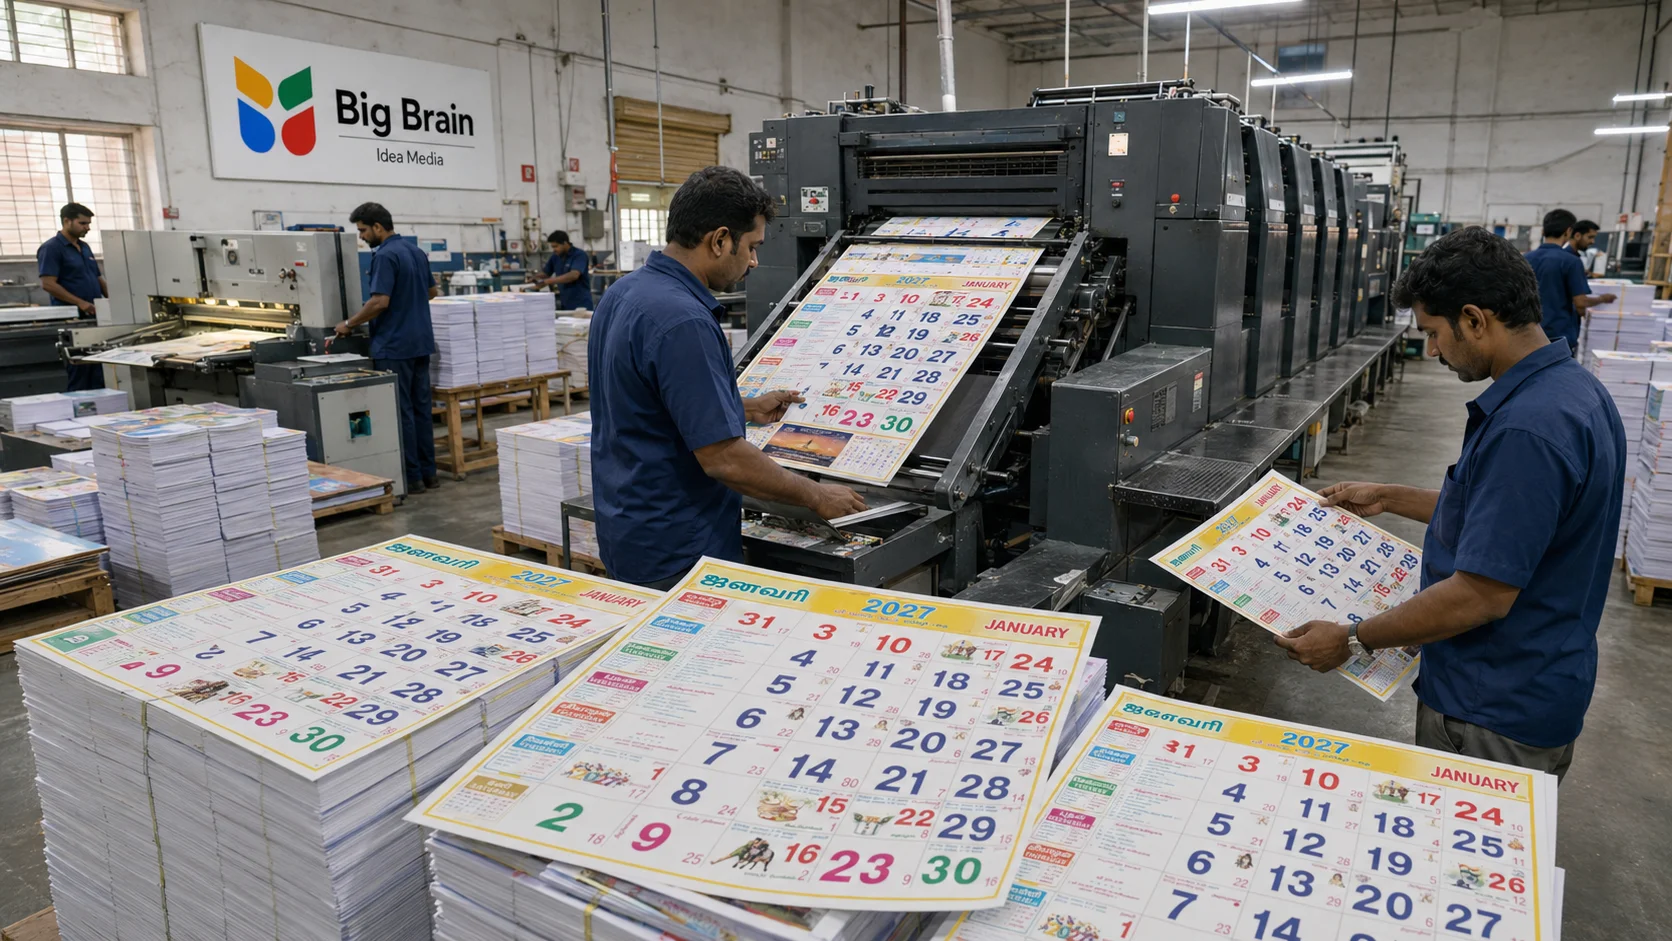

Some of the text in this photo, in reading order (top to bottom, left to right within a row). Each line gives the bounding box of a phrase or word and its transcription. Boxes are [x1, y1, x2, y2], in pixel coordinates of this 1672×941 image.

[336, 89, 474, 137] Big Brain
[377, 148, 443, 166] Idea Media
[965, 280, 1010, 289] JANUARY
[874, 293, 886, 302] 3
[900, 294, 920, 304] 10
[967, 298, 994, 308] 24
[862, 309, 875, 319] 4
[920, 312, 940, 323] 18
[952, 314, 981, 326] 25
[846, 324, 860, 336] 5
[908, 328, 929, 340] 19
[832, 344, 845, 354] 6
[860, 344, 883, 356] 13
[890, 347, 919, 360] 20
[928, 350, 956, 363] 27
[843, 364, 864, 375] 14
[876, 366, 902, 380] 21
[912, 370, 942, 384] 28
[847, 382, 863, 392] 15
[875, 388, 898, 401] 22
[898, 390, 927, 405] 29
[823, 404, 840, 416] 16
[840, 410, 874, 428] 23
[880, 416, 912, 433] 30
[1287, 496, 1308, 512] 24
[1308, 507, 1328, 522] 25
[1251, 528, 1271, 540] 10
[1294, 524, 1312, 536] 18
[1352, 528, 1372, 545] 27
[1232, 546, 1247, 556] 3
[1315, 536, 1334, 550] 19
[1376, 542, 1395, 558] 28
[1256, 558, 1269, 568] 4
[1296, 553, 1316, 566] 12
[1336, 548, 1356, 562] 20
[370, 566, 399, 576] 31
[1211, 558, 1230, 572] 31
[1320, 563, 1340, 578] 13
[421, 580, 444, 588] 3
[511, 570, 572, 588] 2027
[1274, 571, 1291, 582] 5
[700, 573, 810, 603] ஜனவரி
[1298, 584, 1316, 595] 6
[1344, 577, 1363, 593] 14
[381, 592, 406, 600] 4
[463, 592, 498, 604] 10
[579, 591, 645, 608] JANUARY
[1320, 598, 1336, 609] 7
[341, 602, 368, 614] 5
[862, 599, 936, 619] 2027
[297, 619, 324, 629] 6
[462, 614, 497, 627] 18
[548, 614, 590, 628] 24
[738, 612, 775, 629] 31
[248, 630, 276, 644] 7
[340, 630, 376, 644] 13
[425, 630, 462, 644] 19
[508, 627, 554, 644] 25
[813, 624, 836, 640] 3
[985, 620, 1068, 638] JANUARY
[876, 635, 912, 653] 10
[284, 647, 326, 662] 14
[380, 644, 427, 662] 20
[502, 650, 537, 664] 26
[790, 650, 816, 668] 4
[985, 650, 1005, 661] 17
[146, 664, 180, 678] 9
[435, 661, 488, 681] 27
[864, 661, 895, 679] 11
[1010, 654, 1053, 672] 24
[337, 664, 386, 685] 21
[935, 670, 970, 690] 18
[392, 682, 443, 703] 28
[767, 675, 796, 695] 5
[999, 680, 1044, 700] 25
[320, 692, 358, 709] 22
[840, 686, 880, 708] 12
[234, 704, 288, 726] 23
[344, 704, 399, 725] 29
[918, 698, 956, 719] 19
[736, 708, 766, 728] 6
[1018, 711, 1049, 724] 26
[816, 716, 860, 740] 13
[290, 726, 345, 752] 30
[866, 738, 881, 747] 29
[891, 728, 946, 753] 20
[1281, 732, 1350, 754] 2027
[705, 742, 736, 764] 7
[971, 738, 1022, 762] 27
[1163, 740, 1196, 759] 31
[747, 766, 765, 775] 23
[788, 754, 835, 783] 14
[1238, 756, 1260, 772] 3
[652, 768, 664, 780] 1
[876, 766, 926, 796] 21
[1302, 768, 1339, 790] 10
[1432, 766, 1519, 793] JANUARY
[672, 779, 707, 805] 8
[955, 774, 1010, 800] 28
[1222, 784, 1246, 802] 4
[816, 796, 848, 814] 15
[1419, 792, 1440, 806] 17
[718, 805, 737, 816] 24
[1262, 804, 1276, 812] 20
[1300, 798, 1330, 822] 11
[1455, 801, 1504, 826] 24
[536, 802, 583, 832] 2
[895, 808, 934, 826] 22
[1208, 813, 1234, 836] 5
[938, 814, 996, 841] 29
[1374, 813, 1414, 838] 18
[1512, 824, 1523, 832] 10
[588, 834, 605, 844] 18
[632, 822, 671, 852] 9
[1250, 837, 1263, 846] 21
[1283, 828, 1326, 858] 12
[1452, 830, 1504, 858] 25
[682, 852, 704, 864] 25
[786, 844, 821, 864] 16
[1188, 850, 1214, 874] 6
[1368, 848, 1412, 876] 19
[798, 870, 809, 880] 2
[820, 850, 894, 884] 23
[922, 856, 981, 884] 30
[902, 874, 912, 885] 9
[1233, 878, 1248, 888] 22
[1270, 865, 1314, 896] 13
[1430, 876, 1436, 884] 5
[1490, 873, 1525, 894] 26
[1168, 890, 1197, 920] 7
[1326, 896, 1341, 907] 29
[1352, 885, 1412, 920] 20
[1514, 896, 1525, 906] 12
[1121, 921, 1132, 938] 1
[1215, 923, 1231, 934] 23
[1426, 918, 1433, 927] 6
[1446, 904, 1502, 939] 27
